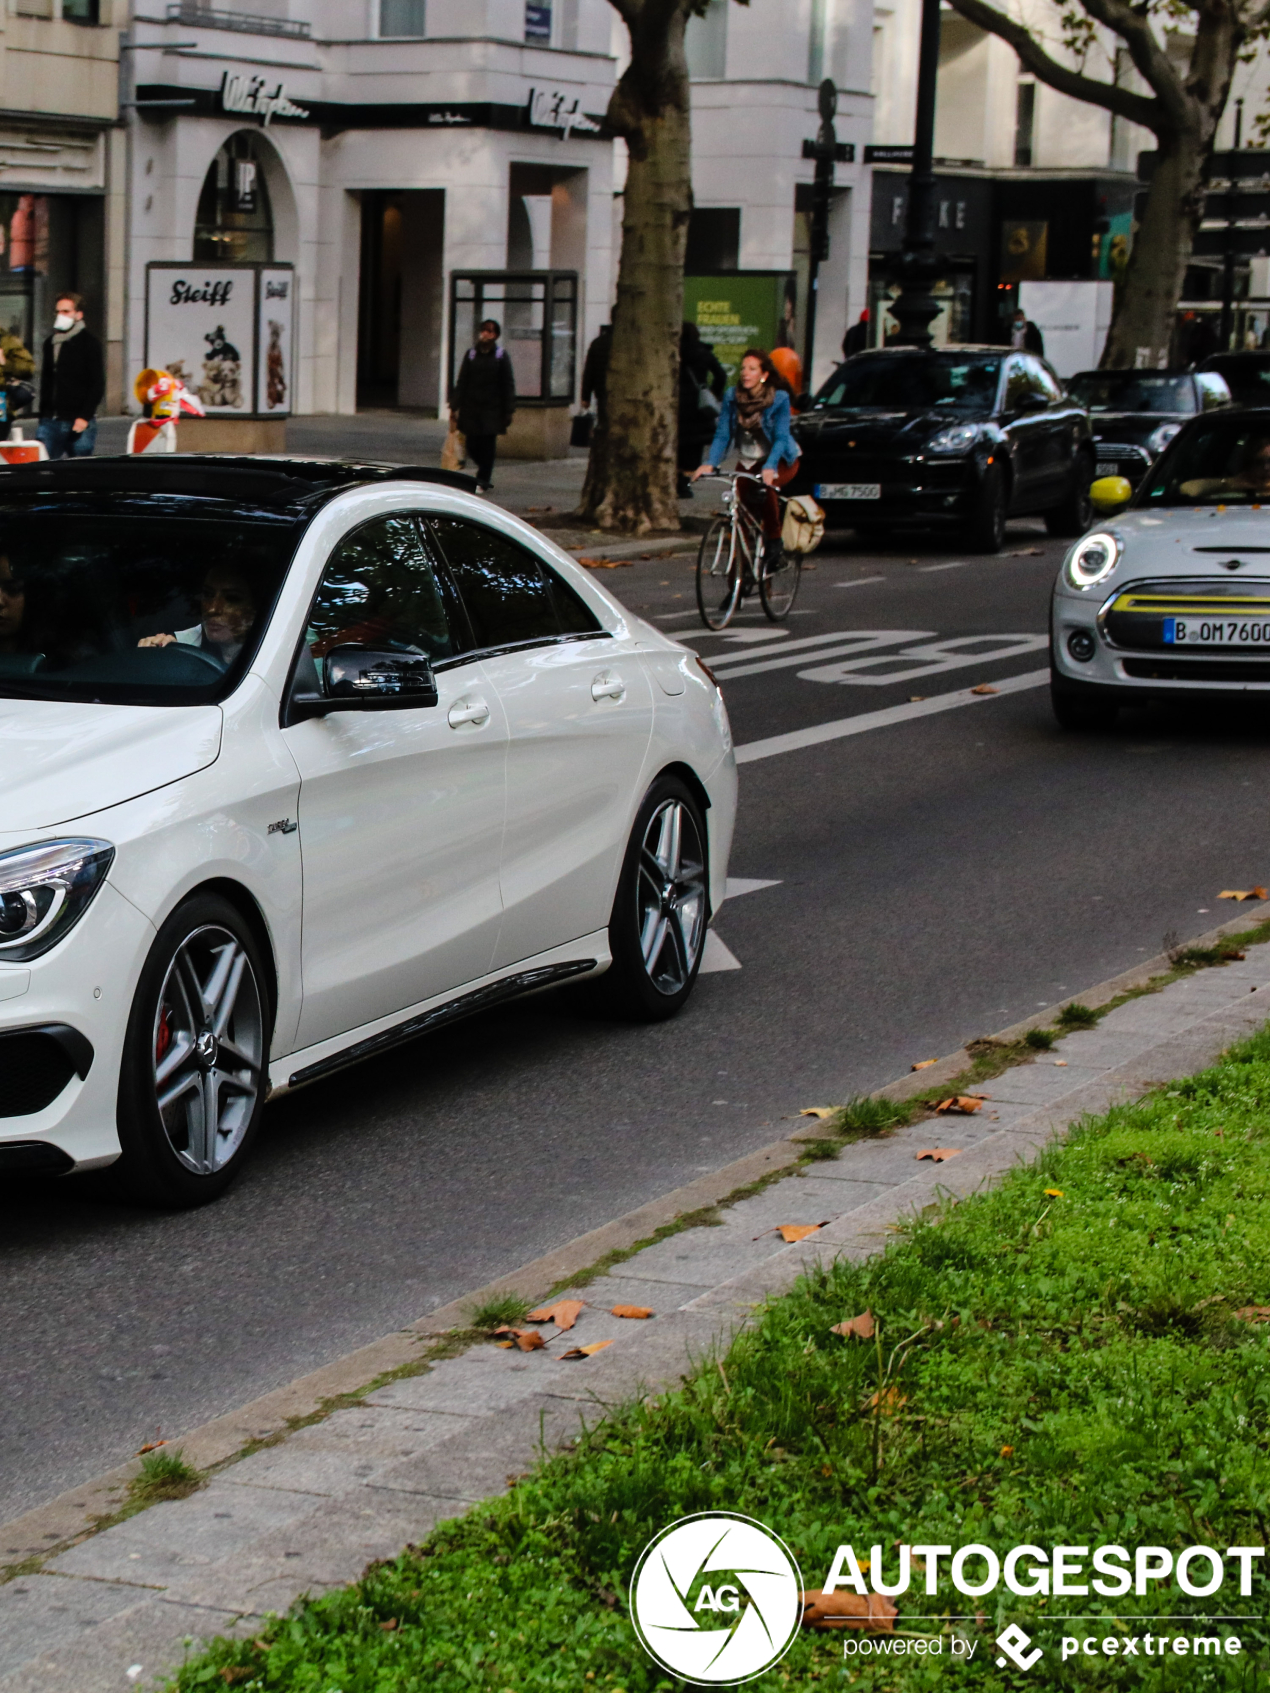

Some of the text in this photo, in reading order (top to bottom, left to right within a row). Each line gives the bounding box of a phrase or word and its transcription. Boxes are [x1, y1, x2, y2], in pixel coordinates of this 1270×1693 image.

[892, 197, 966, 229] FKE
[170, 280, 233, 306] Steiff
[1176, 623, 1186, 640] B
[1200, 623, 1223, 641] OM
